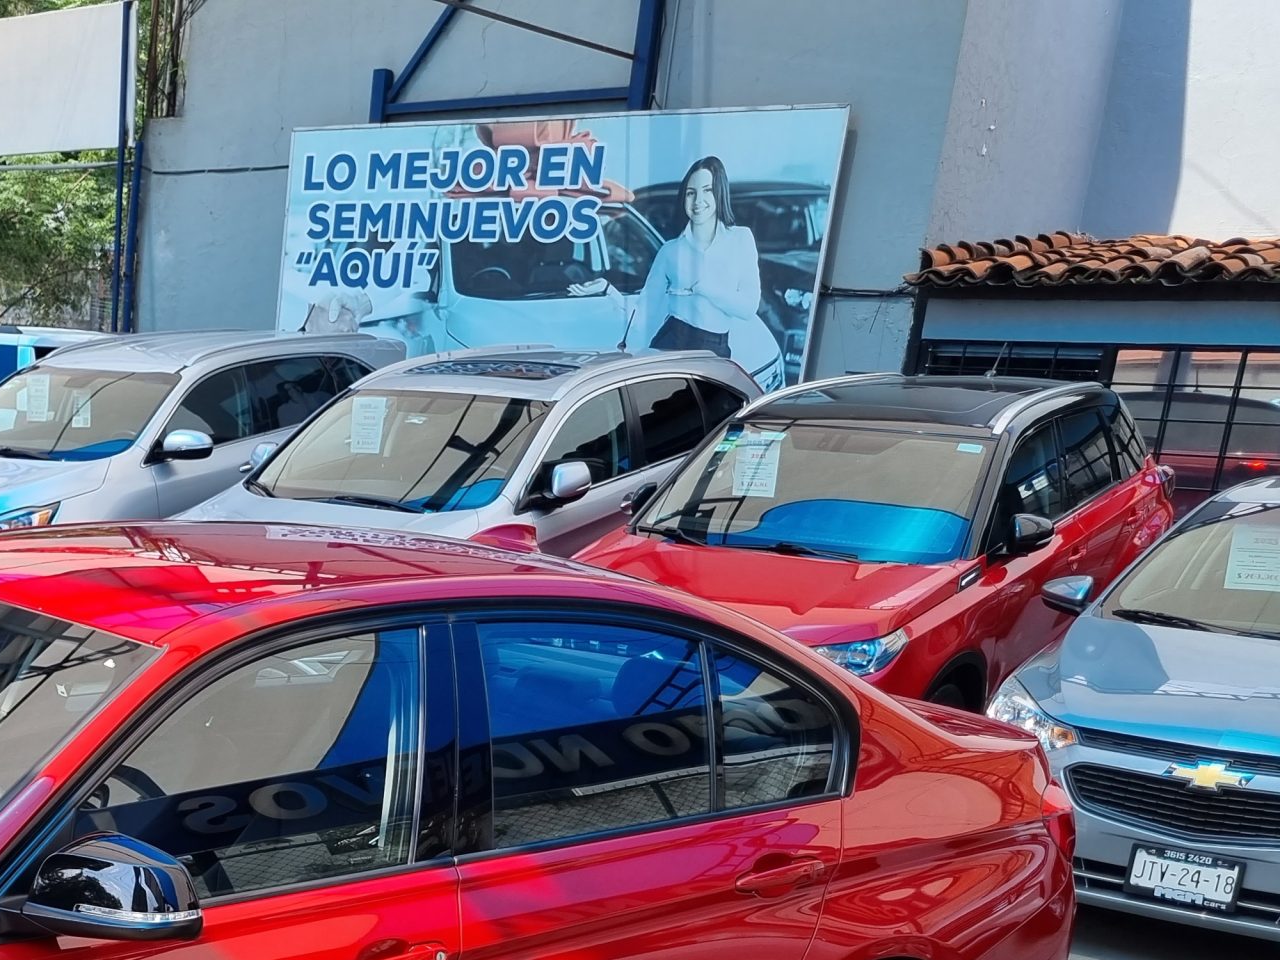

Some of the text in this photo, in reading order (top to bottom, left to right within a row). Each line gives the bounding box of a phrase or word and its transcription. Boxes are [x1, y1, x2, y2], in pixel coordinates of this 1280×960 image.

[303, 145, 605, 191] LO MEJOR EN
[306, 199, 602, 241] SEMINUEVOS
[1164, 849, 1213, 865] 3615 2420
[1133, 859, 1236, 896] JTV-24-18
[1153, 884, 1227, 910] MGM cars
